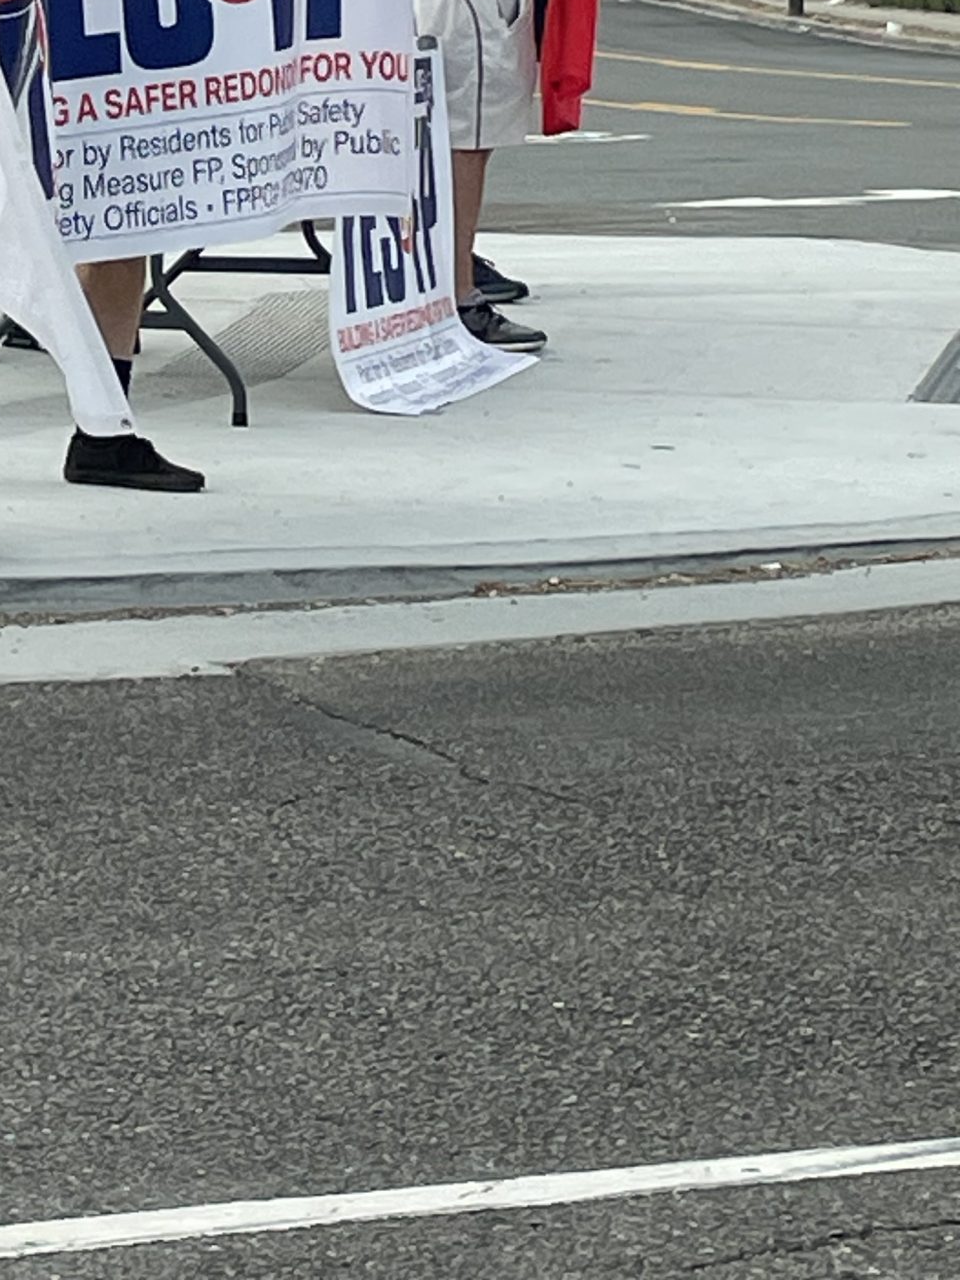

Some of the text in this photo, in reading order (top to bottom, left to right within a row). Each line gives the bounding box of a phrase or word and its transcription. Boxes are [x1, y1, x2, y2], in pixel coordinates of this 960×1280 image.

[76, 92, 99, 124] A
[104, 79, 198, 120] SAFER
[300, 51, 353, 83] FOR
[360, 50, 409, 82] YOU
[82, 141, 112, 170] by
[119, 125, 233, 162] Residents
[238, 117, 265, 145] for
[296, 96, 367, 129] Safety
[82, 166, 185, 201] Measure
[191, 155, 227, 186] FP,
[300, 134, 328, 164] by
[333, 128, 402, 158] Public
[57, 211, 96, 242] ety
[102, 195, 199, 232] Officials
